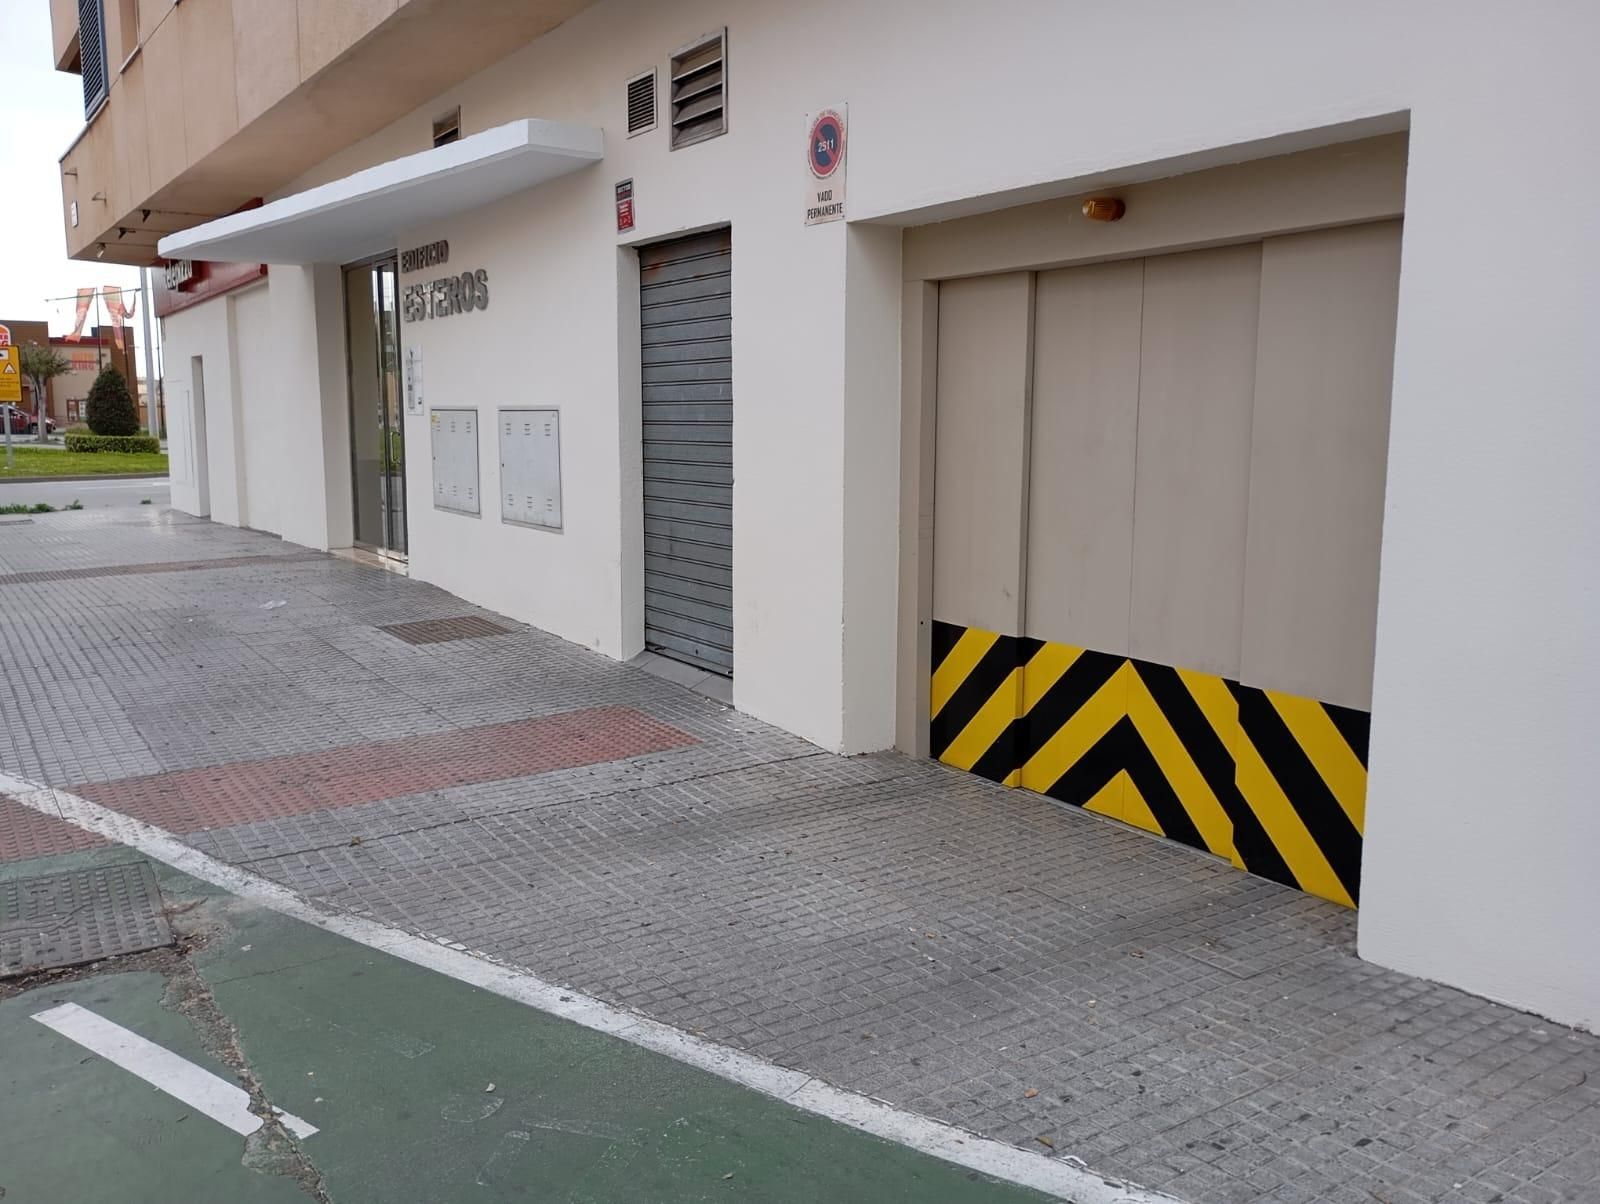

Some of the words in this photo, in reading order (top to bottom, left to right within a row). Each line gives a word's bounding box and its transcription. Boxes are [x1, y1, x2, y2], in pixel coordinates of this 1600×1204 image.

[818, 138, 834, 152] 2511
[817, 189, 833, 202] VADO
[807, 202, 843, 219] PERMANENTE
[401, 240, 449, 274] EDIFICIO
[402, 268, 489, 323] ESTEROS
